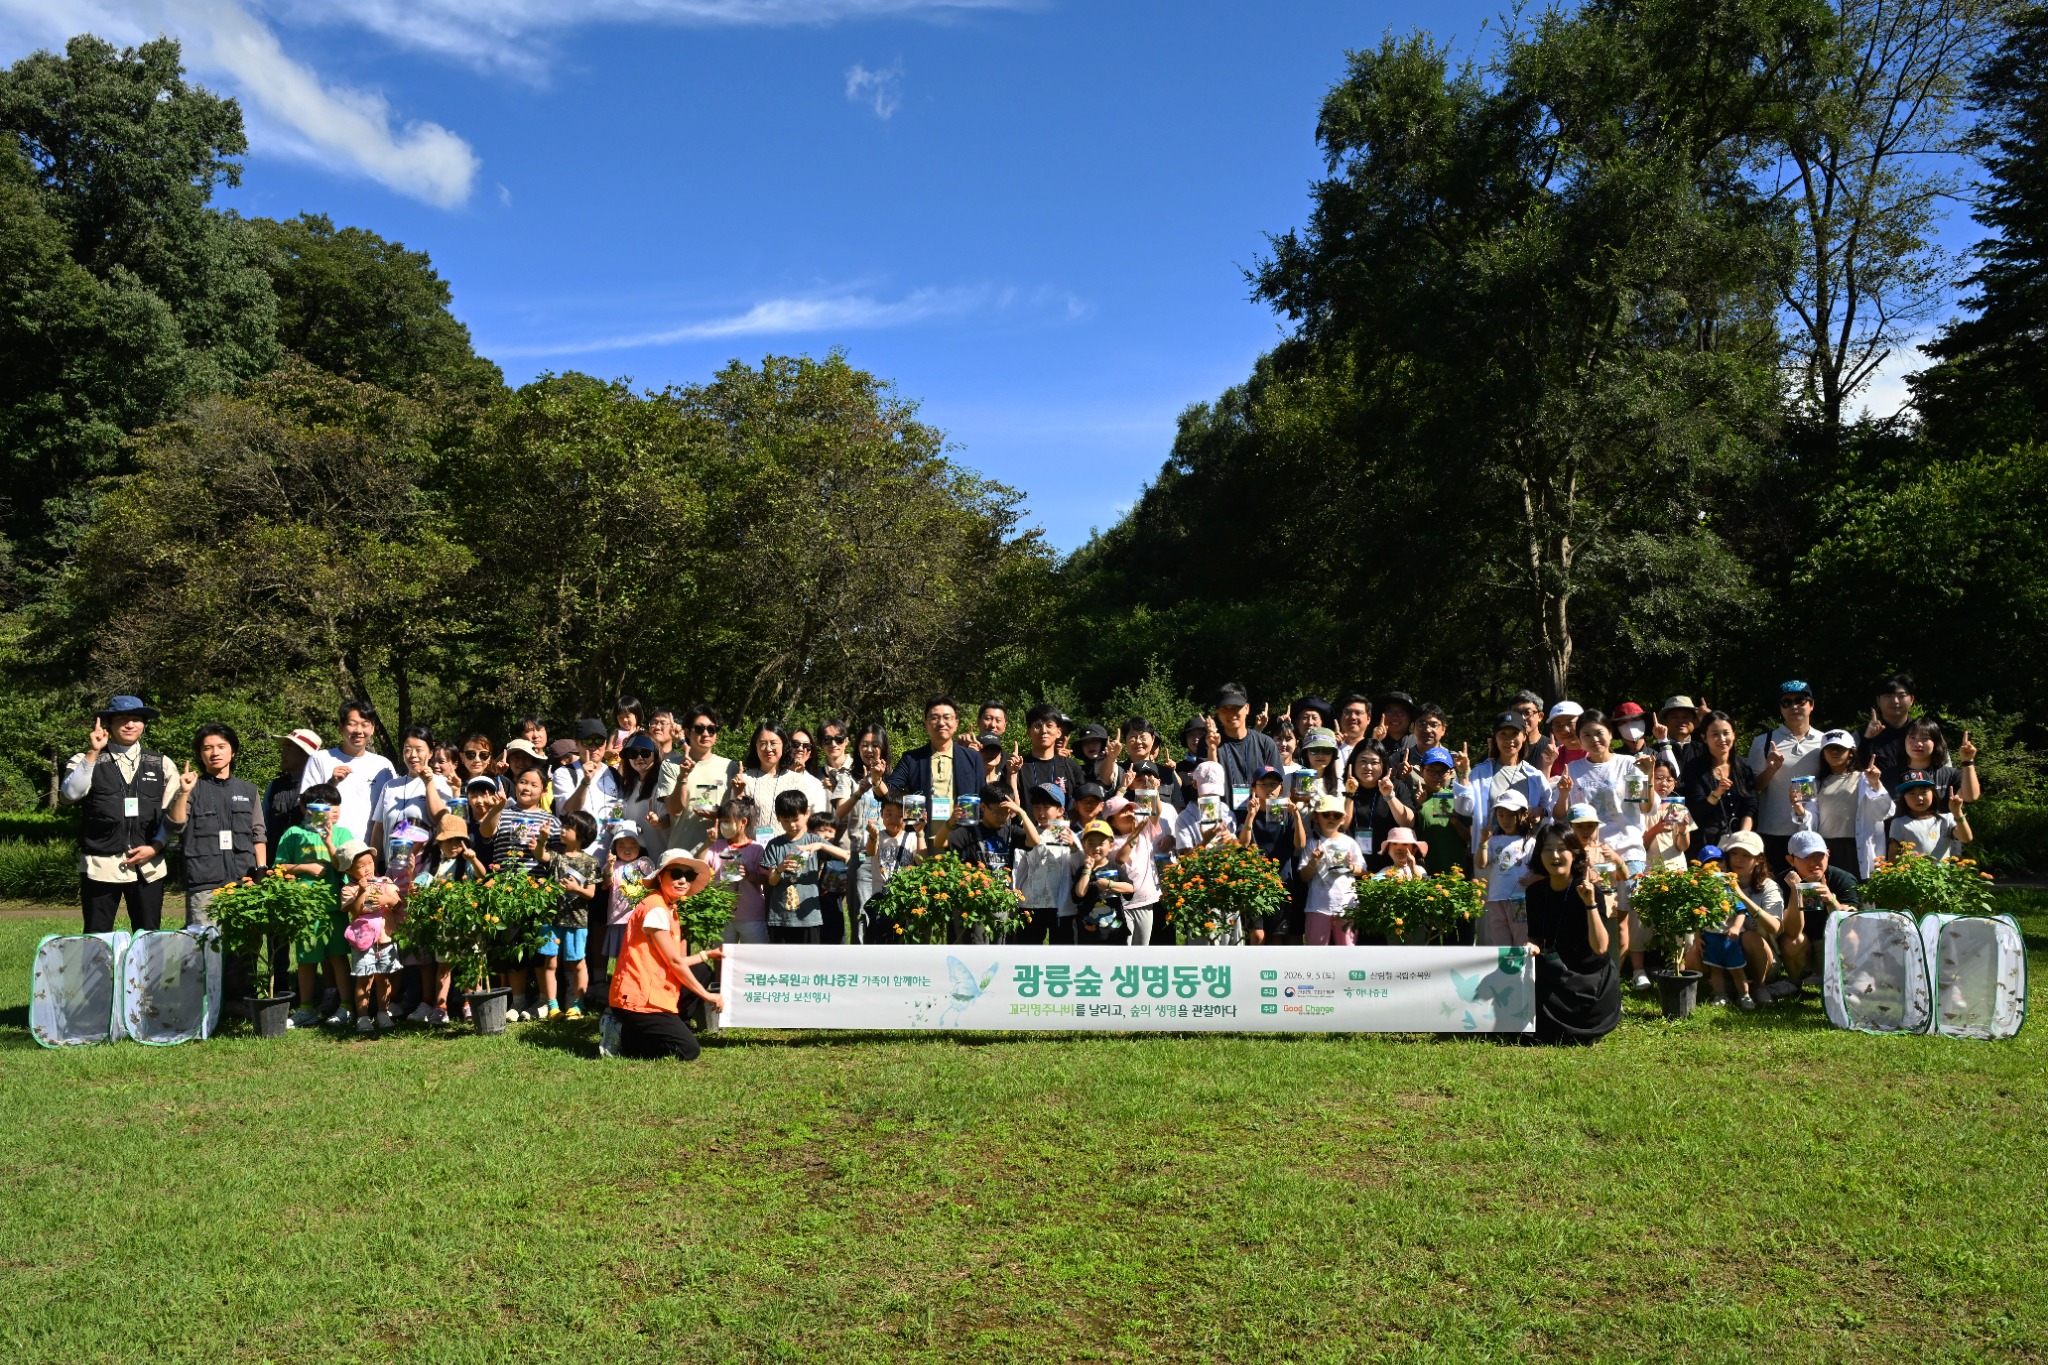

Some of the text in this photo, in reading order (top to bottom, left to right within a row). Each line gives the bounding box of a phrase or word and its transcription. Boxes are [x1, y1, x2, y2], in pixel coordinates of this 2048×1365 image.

[1262, 971, 1275, 979] 일시
[1284, 971, 1304, 980] 2026.
[1370, 971, 1431, 980] 산림청 국립수목원
[744, 973, 931, 987] 국립수목원과 하나증권 가족이 함께하는
[1013, 964, 1232, 998] 광릉숲 생명동행
[1263, 988, 1275, 996] 주최
[1356, 988, 1388, 998] 하나증권
[743, 991, 831, 1003] 생물다양성 보전행사
[1009, 1003, 1237, 1019] 꼬리명주나비를 날리고, 숲의 생명을 관찰하다
[1305, 1005, 1335, 1013] Change
